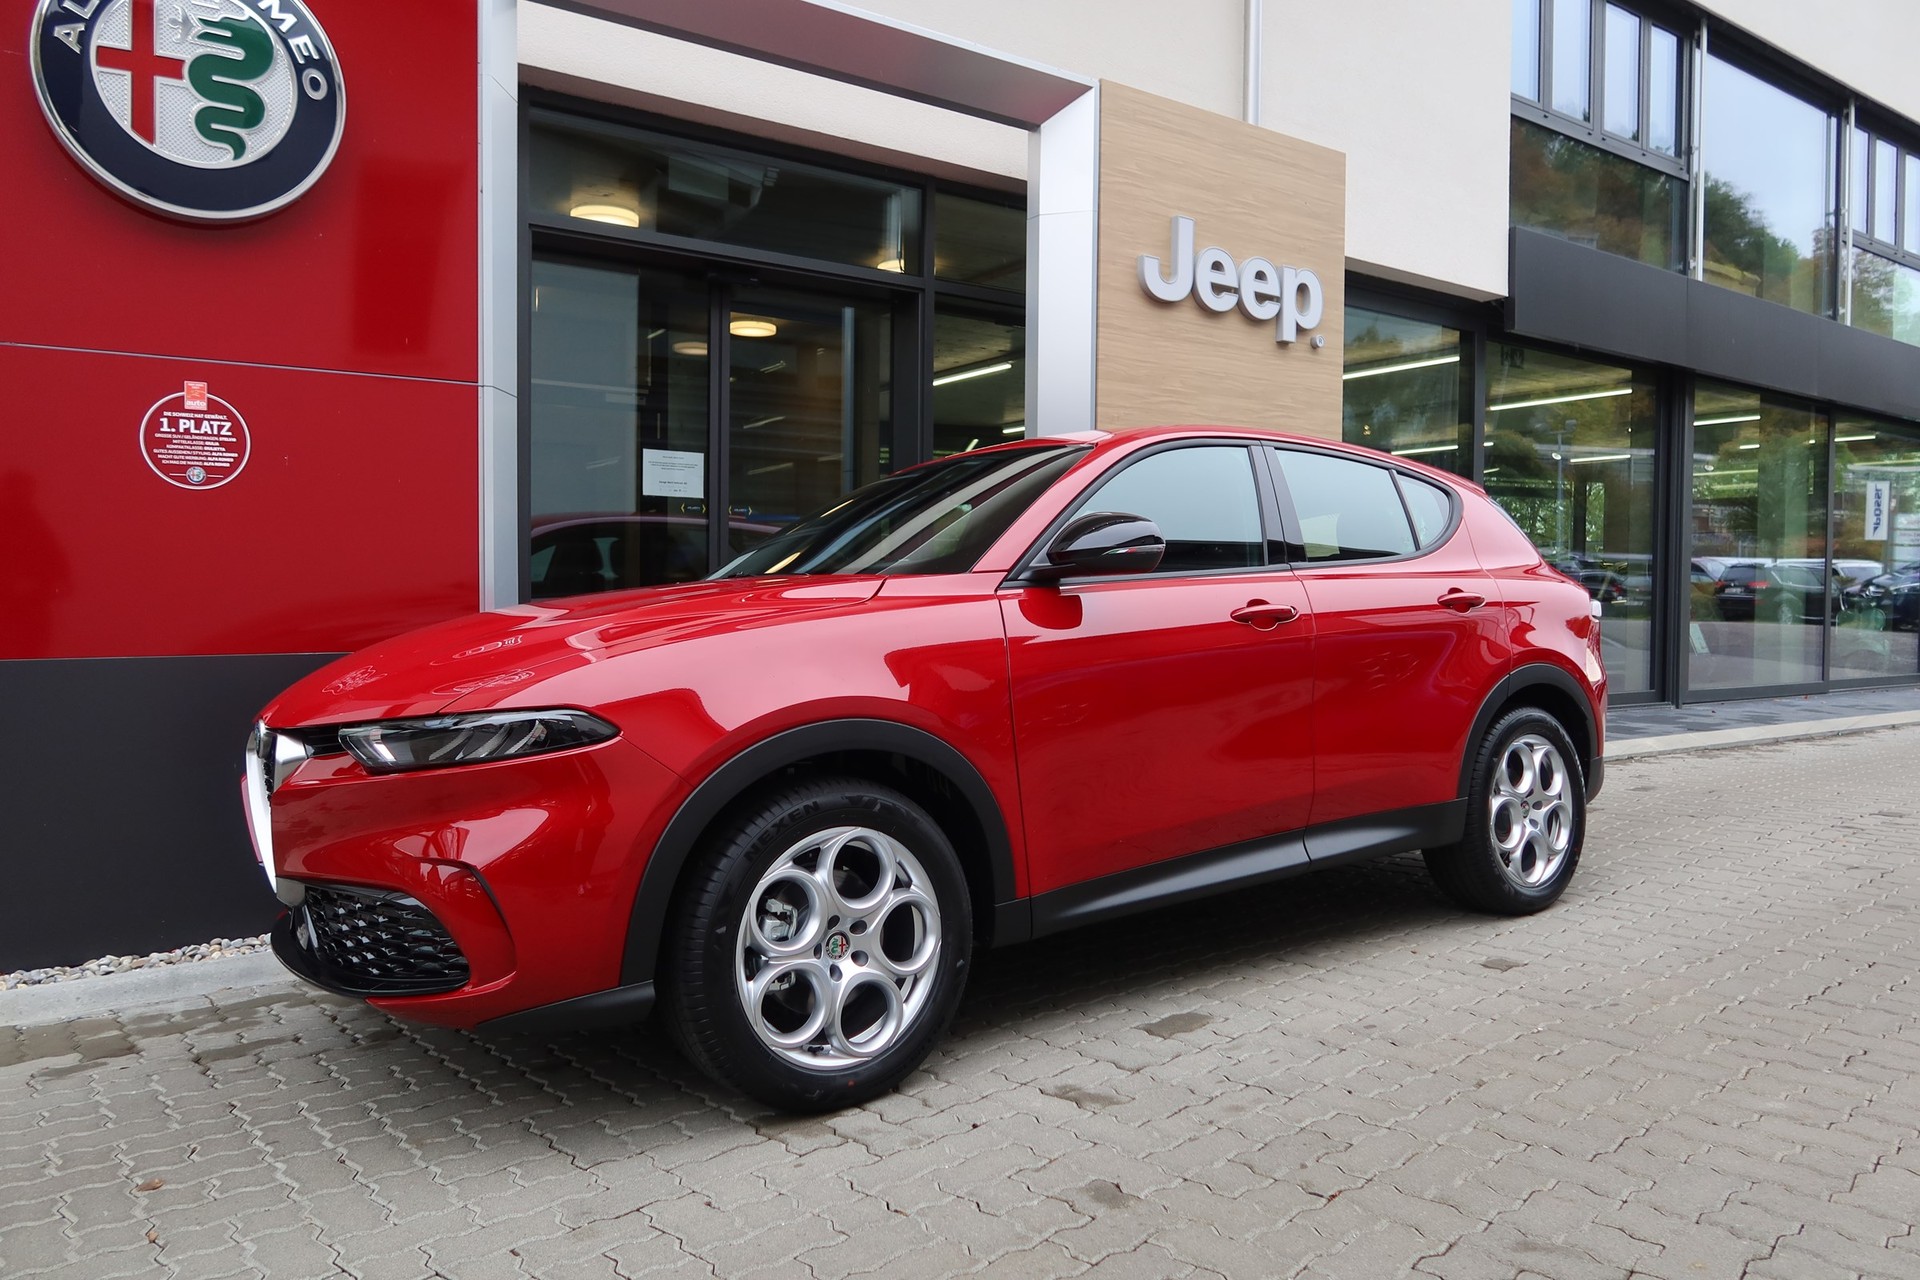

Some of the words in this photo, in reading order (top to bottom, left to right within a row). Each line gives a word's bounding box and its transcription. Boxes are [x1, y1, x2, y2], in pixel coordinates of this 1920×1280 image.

[160, 418, 175, 432] 1.
[179, 419, 232, 435] PLATZ
[744, 801, 820, 860] NEXEN
